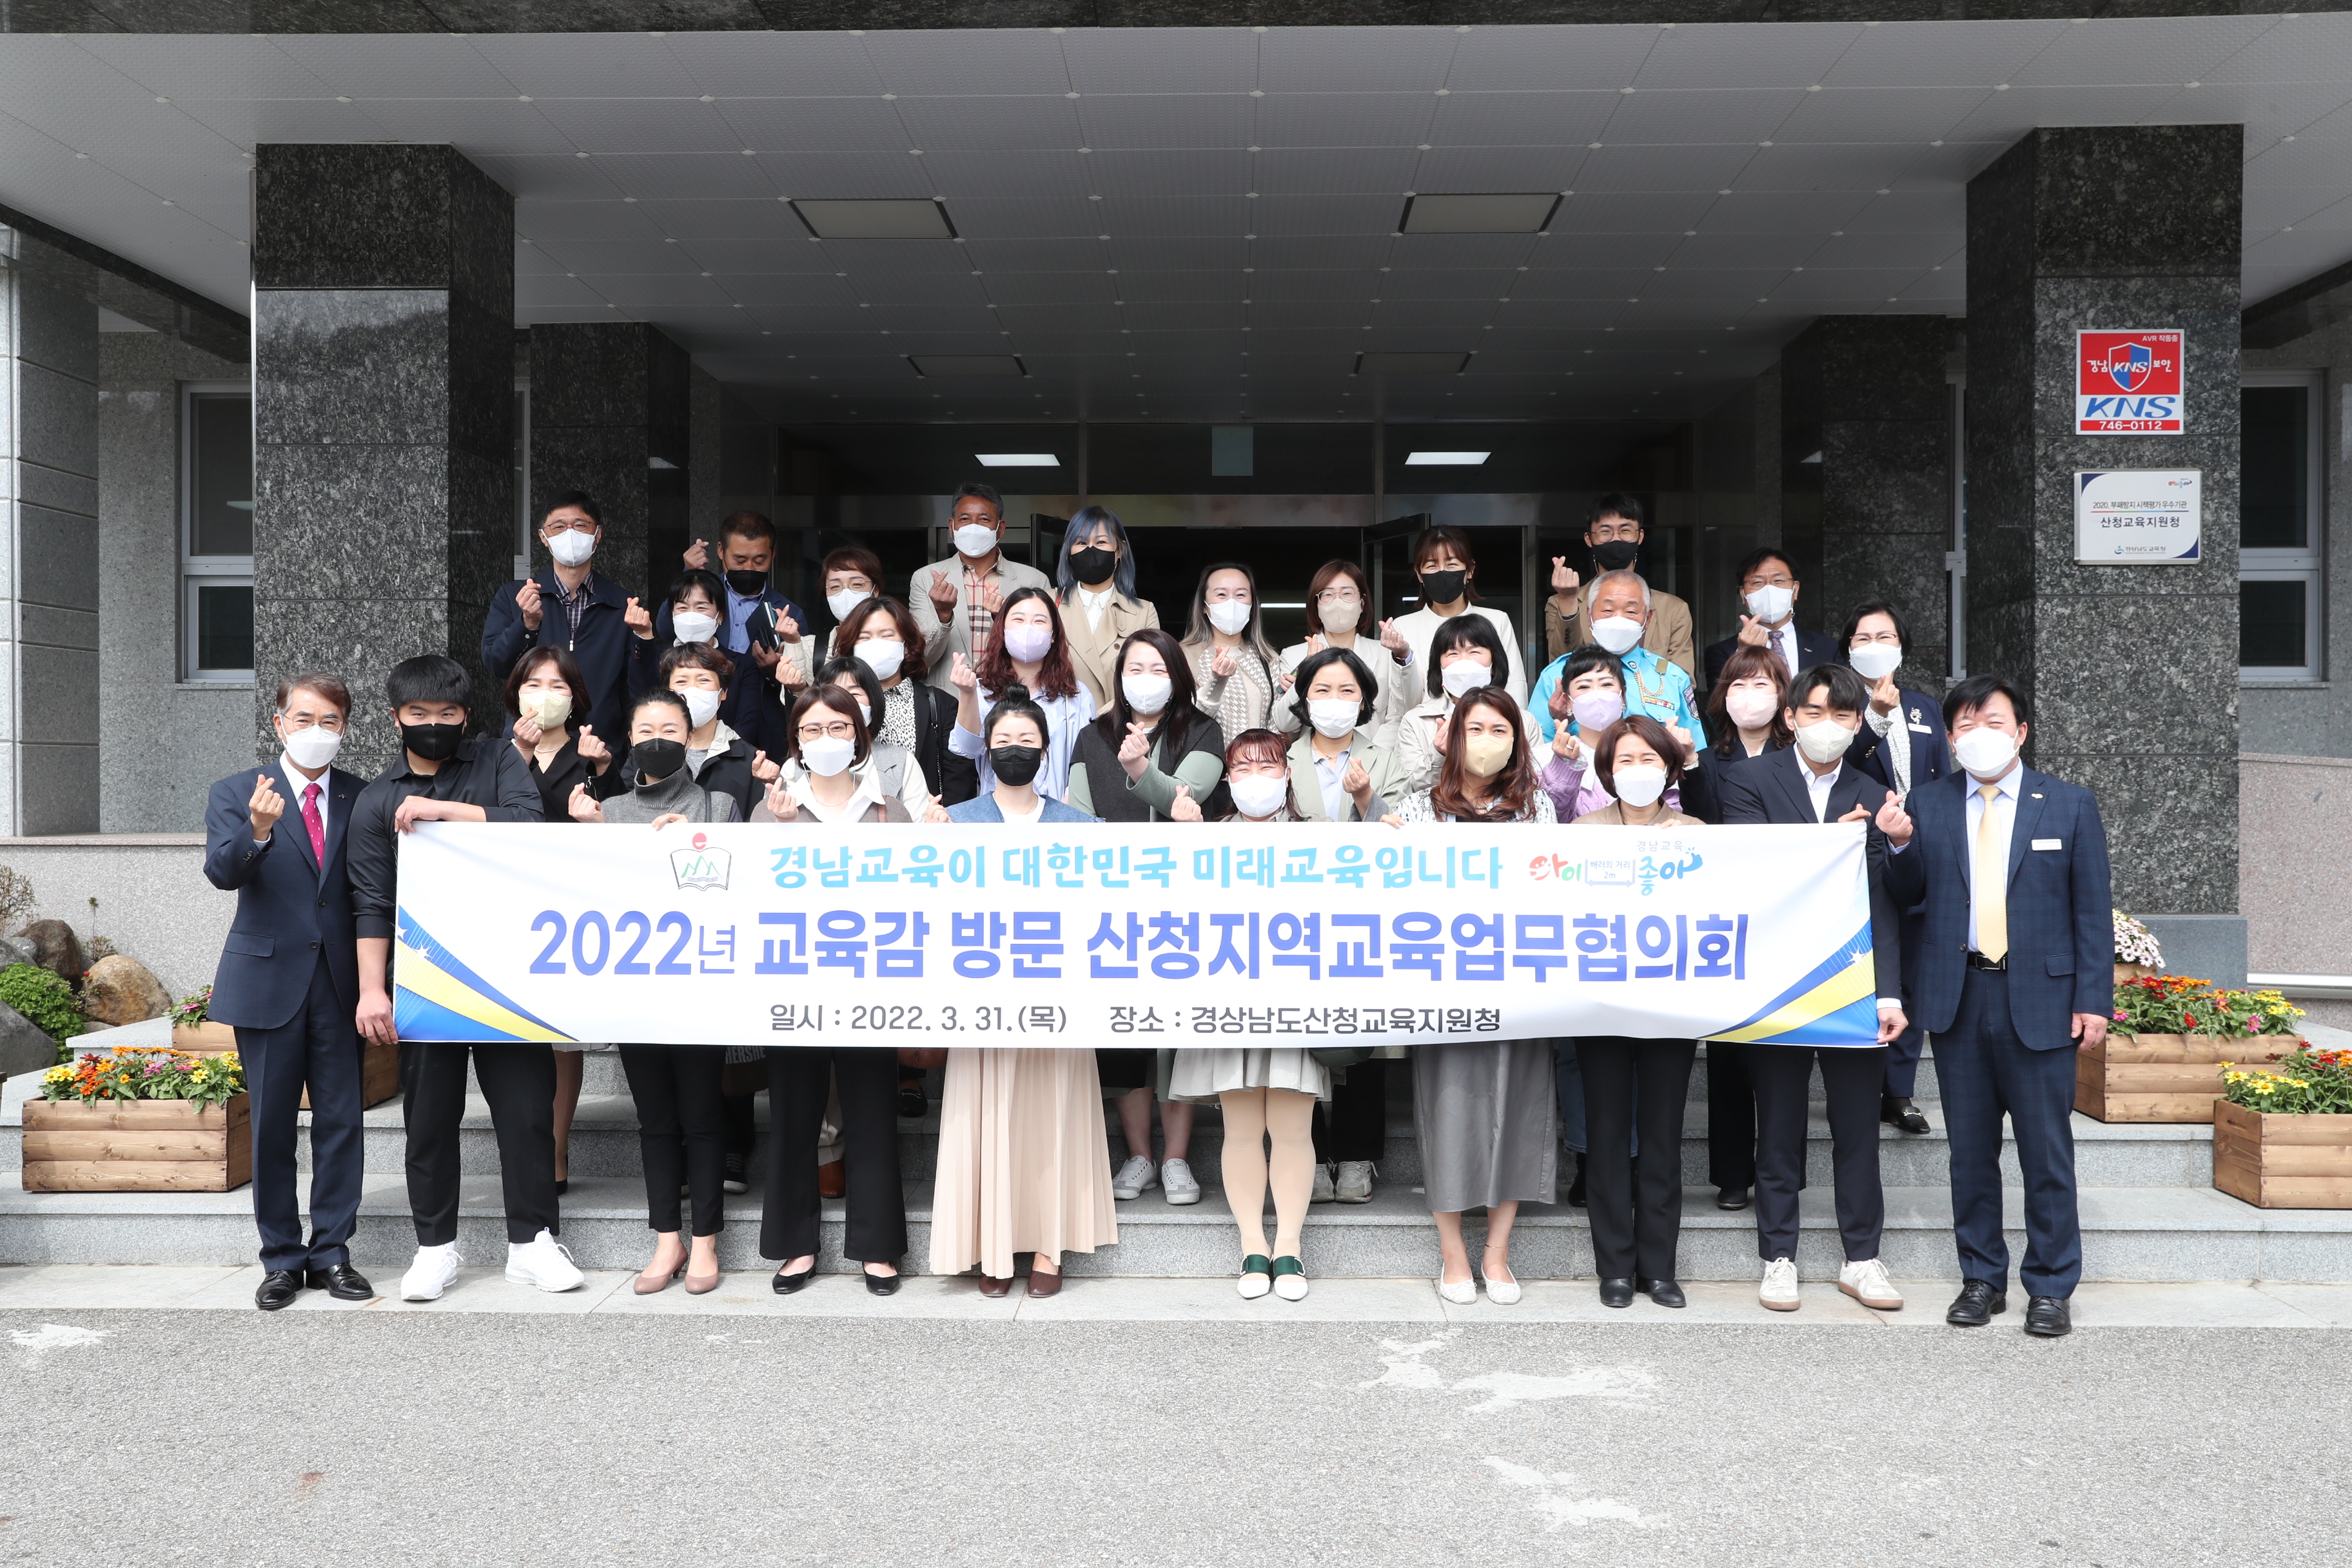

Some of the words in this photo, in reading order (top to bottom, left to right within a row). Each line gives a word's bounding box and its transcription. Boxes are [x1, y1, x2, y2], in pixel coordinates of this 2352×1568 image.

[2086, 360, 2108, 373] 경남
[2113, 362, 2148, 373] KNS
[2153, 359, 2172, 373] 보안
[2084, 397, 2176, 418] KNS
[2099, 420, 2162, 431] 746-0112
[2111, 501, 2135, 509] 부패방지
[2162, 500, 2187, 509] 우수기관
[2101, 516, 2180, 528] 산청교육지원청
[1636, 840, 1683, 852] 경남교육
[770, 845, 985, 889] 경남교육이
[1003, 842, 1177, 888] 대한민국
[1193, 845, 1504, 889] 미래교육입니다
[1590, 860, 1612, 870] 배려의
[1615, 860, 1631, 870] 거리
[529, 910, 736, 976] 2022년
[754, 910, 930, 978] 교육감
[952, 911, 1064, 979] 방문
[1087, 910, 1749, 983] 산청지역교육업무협의회
[770, 1004, 823, 1032] 일시
[852, 1005, 931, 1031] 2022.
[941, 1006, 965, 1032] 3.
[975, 1006, 1066, 1033] 31.(목)
[1110, 1006, 1164, 1033] 장소
[1191, 1006, 1500, 1034] 경상남도산청교육지원청
